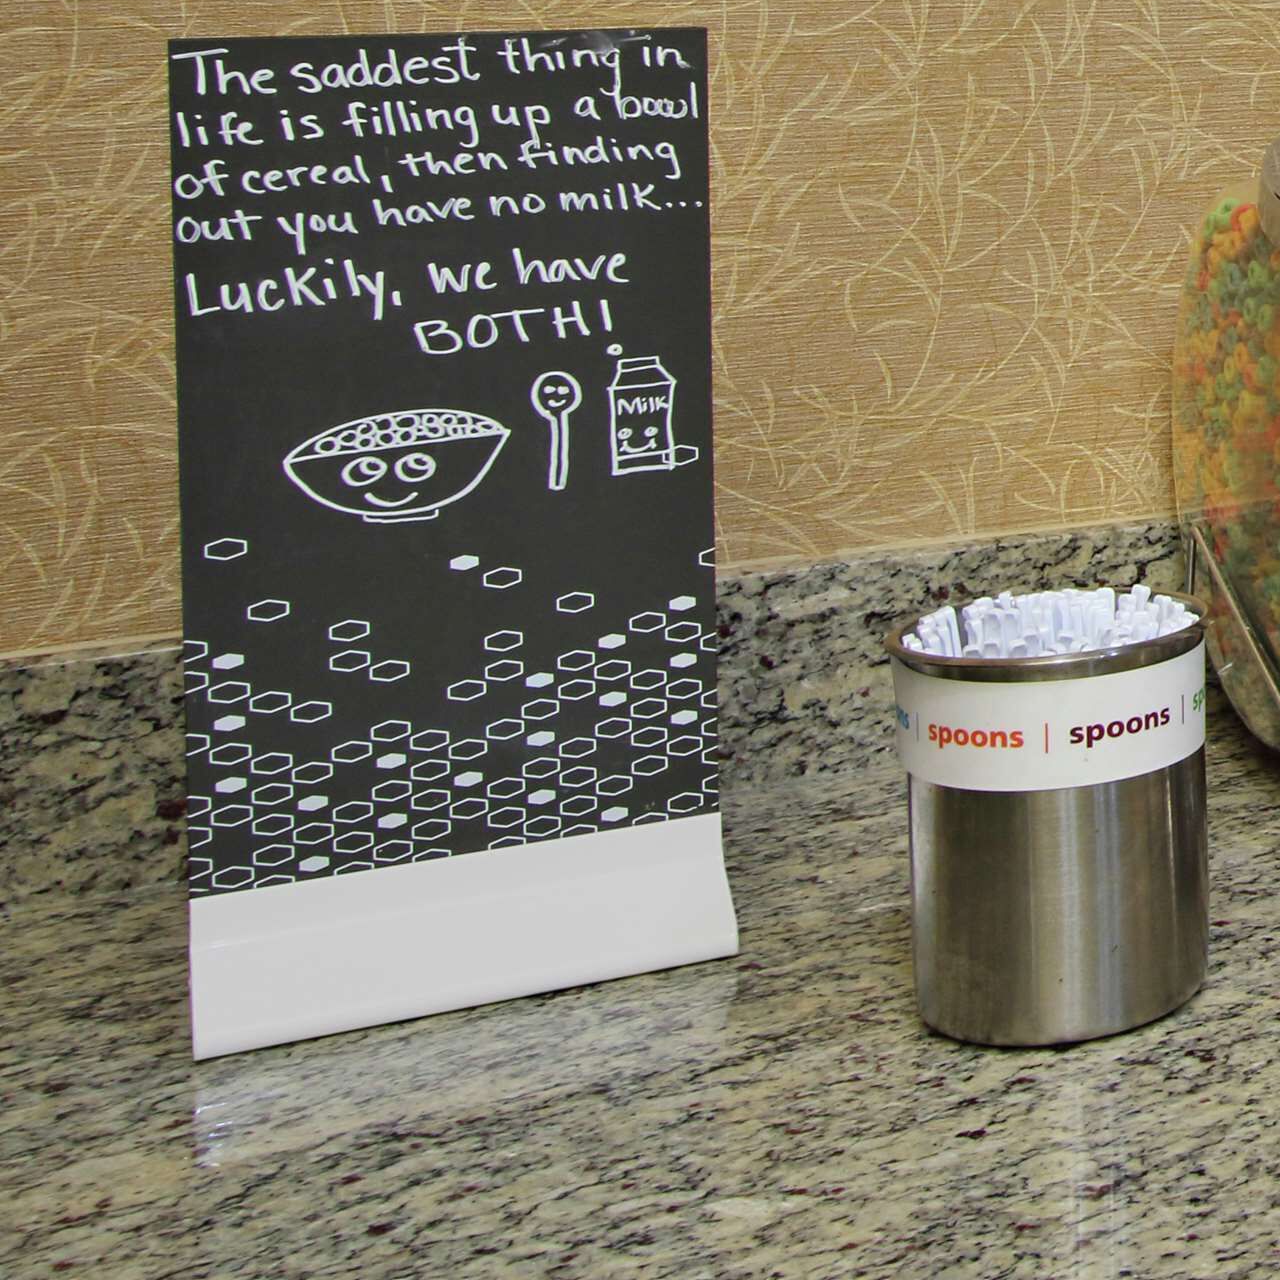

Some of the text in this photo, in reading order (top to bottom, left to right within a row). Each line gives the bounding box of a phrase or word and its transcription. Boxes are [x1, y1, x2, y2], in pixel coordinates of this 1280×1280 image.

[173, 38, 691, 97] The saddest thing in
[176, 111, 264, 147] life
[280, 108, 324, 142] is
[342, 100, 478, 147] filling
[491, 101, 551, 146] up
[574, 97, 600, 119] a
[173, 135, 681, 199] of cereal, then finding
[175, 209, 263, 243] out
[277, 211, 358, 256] you
[372, 198, 475, 227] have
[490, 192, 546, 217] no
[512, 247, 630, 285] have
[413, 298, 623, 356] BOTH!
[617, 395, 668, 416] Milk
[928, 707, 1170, 749] spoons spoons
